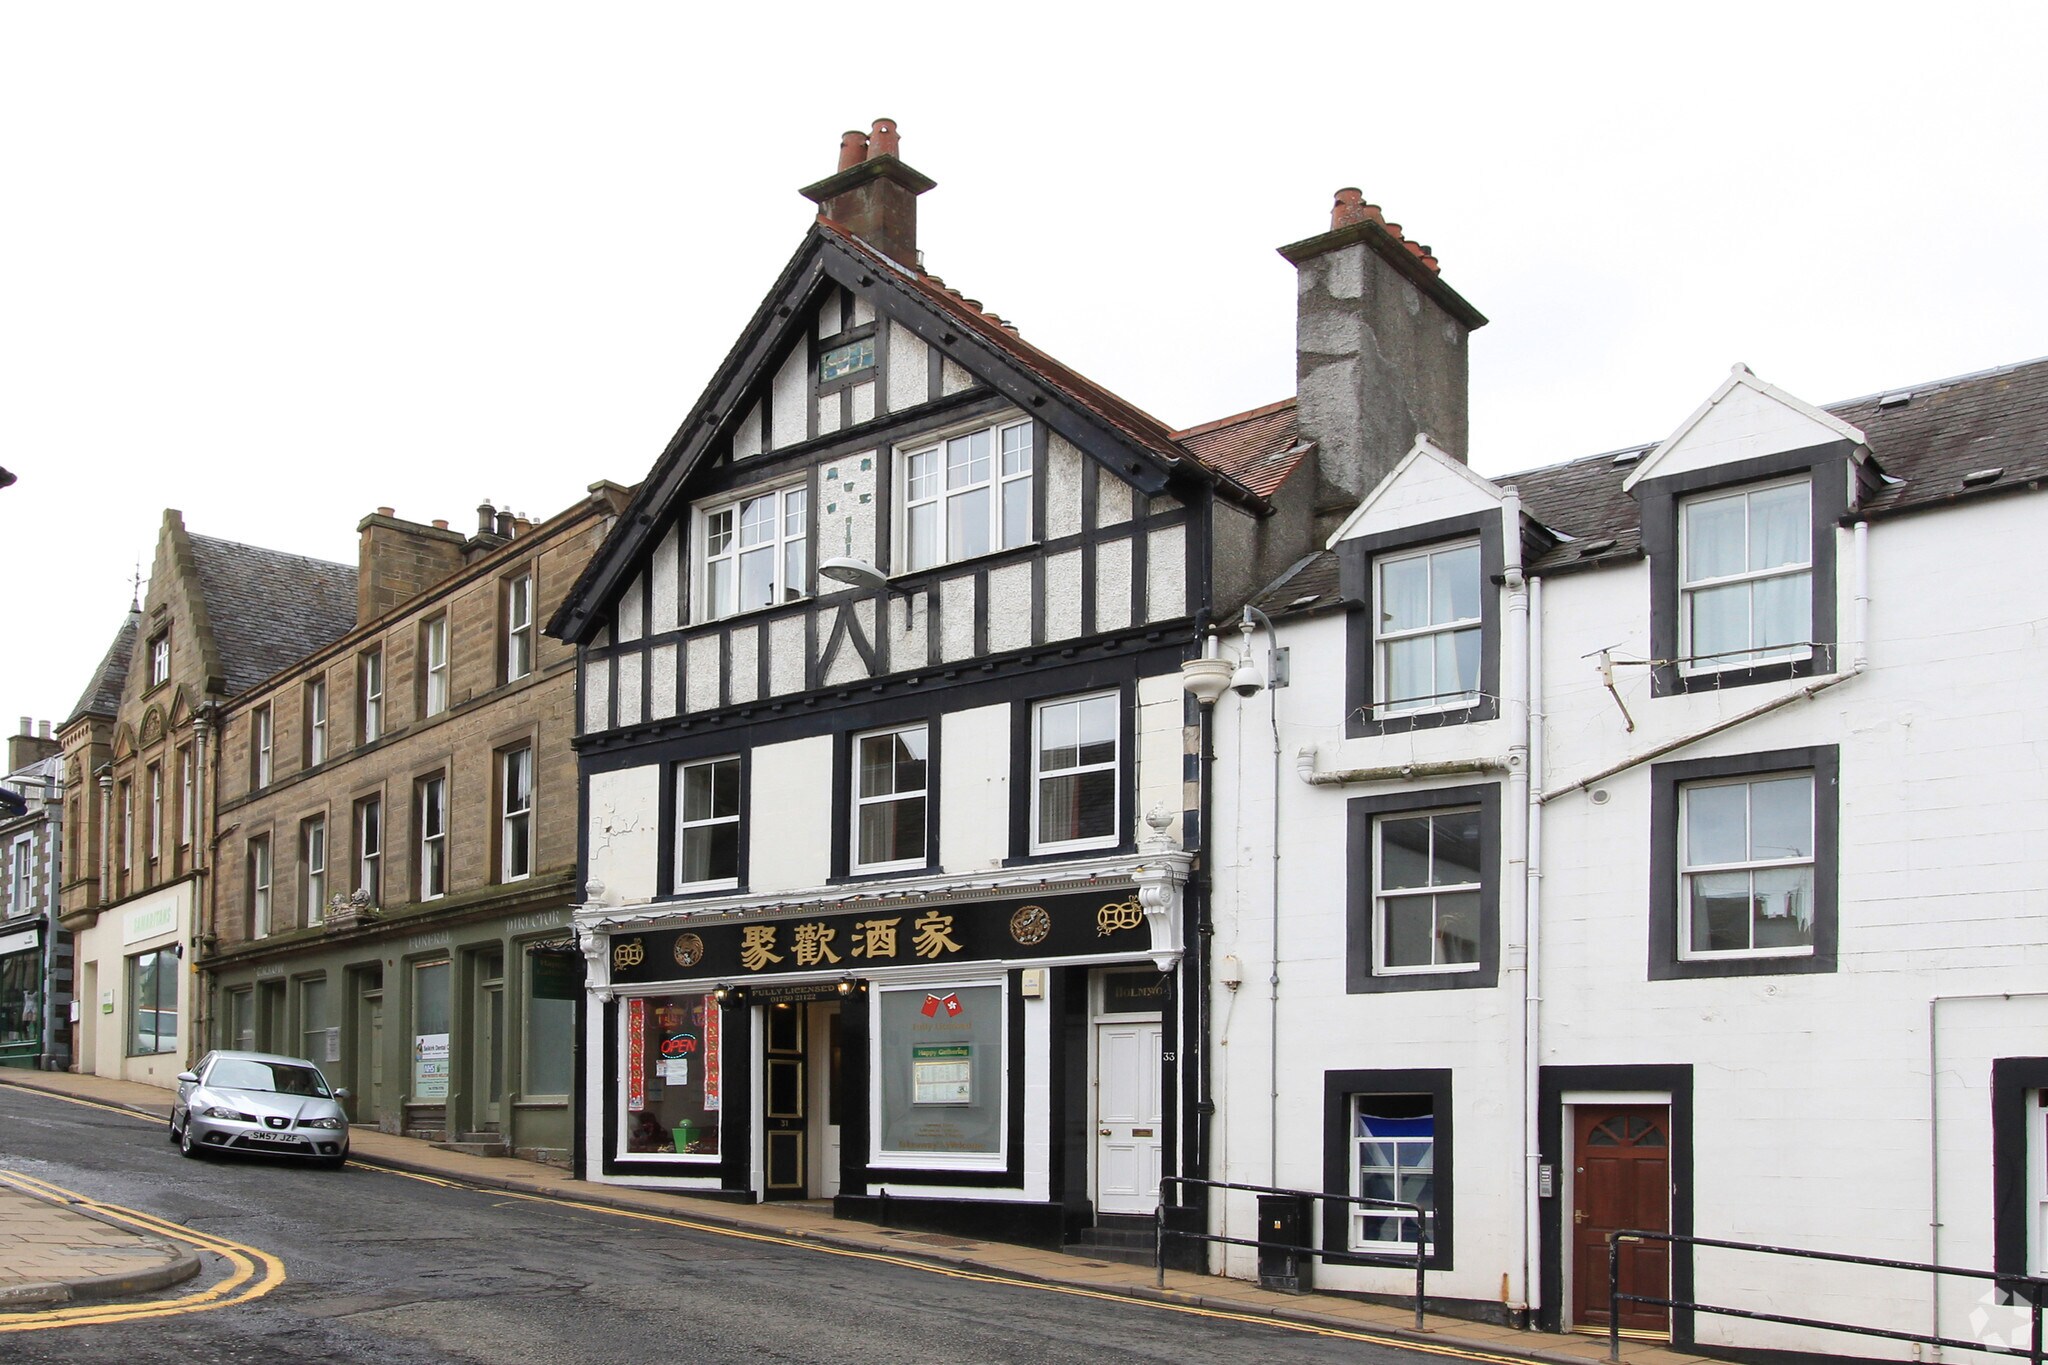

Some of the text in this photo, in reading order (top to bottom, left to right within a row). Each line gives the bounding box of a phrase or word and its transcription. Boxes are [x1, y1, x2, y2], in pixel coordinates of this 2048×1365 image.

[408, 911, 560, 949] FUNERAL DIRECTOR
[741, 911, 963, 971] 聚歡酒家
[752, 984, 835, 997] FULLY LICENSED
[661, 1039, 698, 1053] OPEN
[918, 1047, 968, 1057] Happy Gathering
[1163, 1052, 1175, 1061] 33
[280, 1134, 298, 1142] JZF
